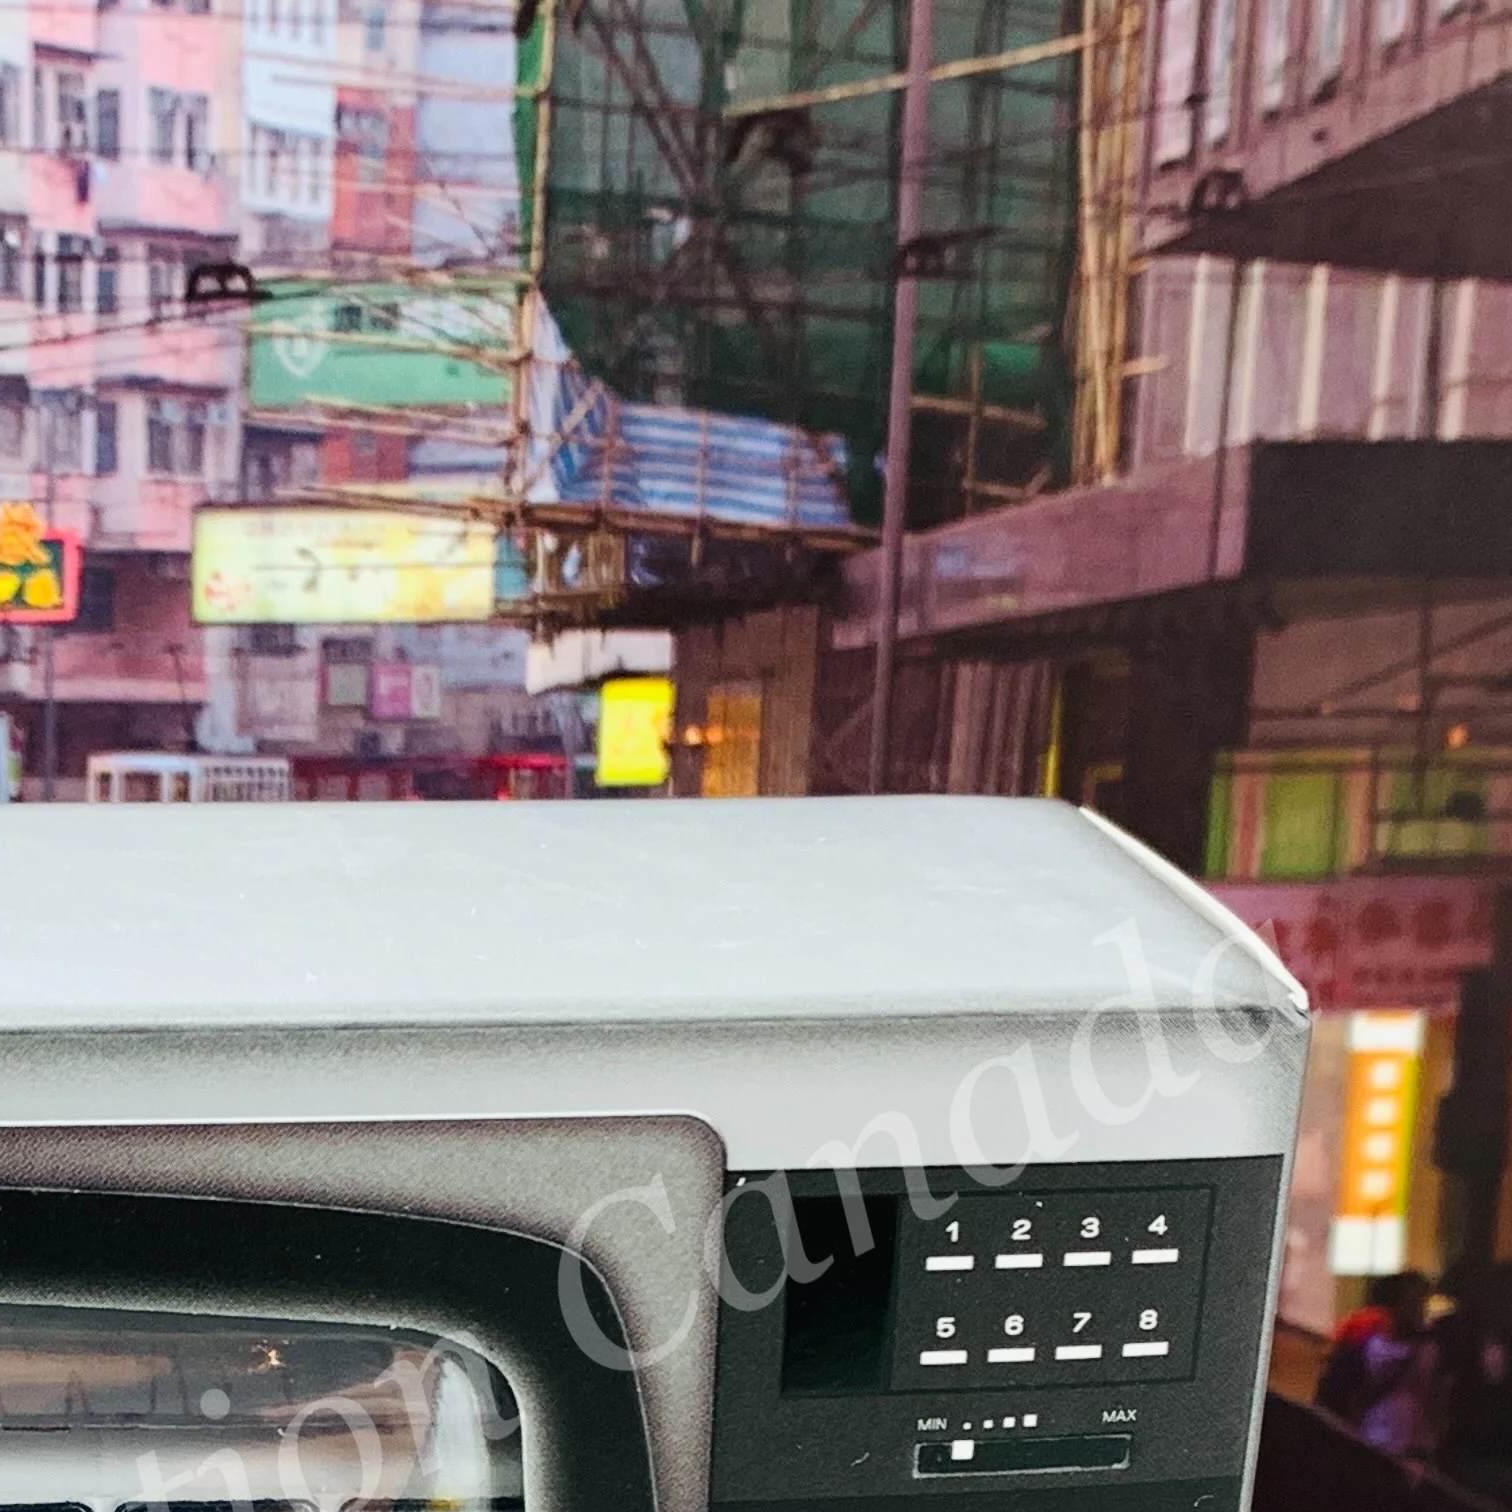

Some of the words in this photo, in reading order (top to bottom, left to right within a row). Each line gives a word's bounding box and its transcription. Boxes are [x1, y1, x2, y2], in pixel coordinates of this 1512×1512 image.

[944, 1220, 960, 1242] 1
[1010, 1218, 1032, 1240] 2
[1080, 1216, 1101, 1238] 3
[1147, 1214, 1169, 1236] 4
[935, 1316, 956, 1338] 5
[1004, 1314, 1025, 1336] 6
[1072, 1311, 1092, 1333] 7
[1138, 1308, 1159, 1330] 8
[917, 1418, 948, 1432] MIN
[1101, 1409, 1138, 1423] MAX
